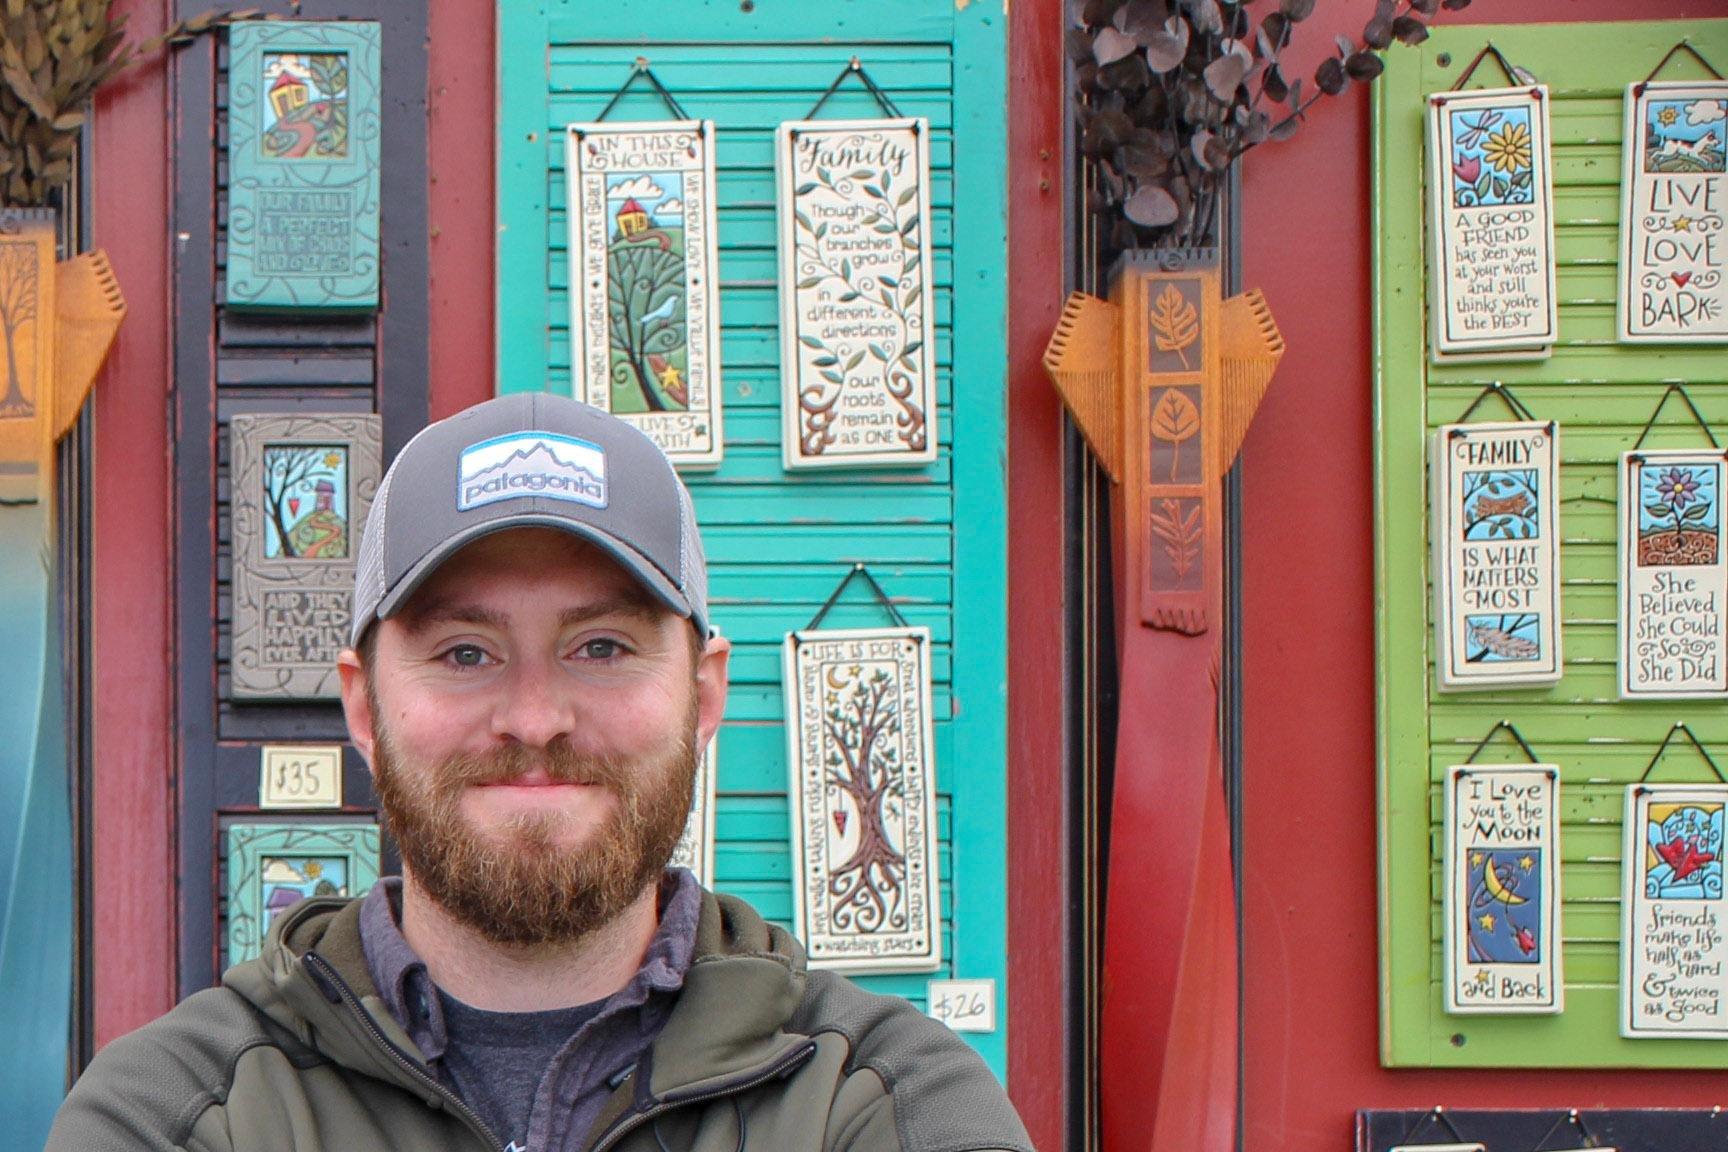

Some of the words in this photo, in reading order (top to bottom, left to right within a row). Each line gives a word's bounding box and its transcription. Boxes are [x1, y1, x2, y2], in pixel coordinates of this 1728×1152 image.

[599, 139, 622, 152] IN
[631, 136, 674, 152] THIS
[612, 153, 682, 168] HOUSE
[799, 137, 909, 174] Family
[1651, 179, 1719, 212] LIVE
[812, 205, 864, 220] Though
[1456, 214, 1471, 227] A
[832, 223, 861, 236] our
[1463, 228, 1529, 246] FRIEND
[827, 238, 892, 252] branches
[1456, 246, 1477, 262] has
[1483, 246, 1511, 261] seen
[1515, 246, 1536, 259] you
[1644, 236, 1721, 266] LOVE
[854, 254, 889, 268] grow
[1456, 265, 1468, 278] at
[1472, 266, 1499, 280] your
[1504, 262, 1538, 275] worst
[1468, 282, 1493, 294] and
[1499, 279, 1526, 294] still
[819, 291, 830, 302] in
[1457, 298, 1497, 313] thinks
[808, 306, 878, 322] different
[1643, 292, 1711, 328] BARK
[823, 322, 897, 338] directions
[1465, 316, 1489, 330] the
[1493, 315, 1531, 329] BEST
[850, 376, 880, 388] our
[843, 392, 885, 408] roots
[841, 412, 894, 426] remain
[842, 433, 861, 444] as
[865, 430, 894, 444] ONE
[1456, 440, 1539, 465] FAMILY
[466, 472, 601, 503] patagonia
[1463, 550, 1478, 566] IS
[1486, 547, 1539, 565] WHAT
[1463, 567, 1538, 587] MATTERS
[1653, 573, 1696, 593] She
[265, 592, 300, 609] AND
[307, 592, 349, 611] THEY
[1464, 589, 1538, 608] MOST
[1640, 592, 1714, 613] Believed
[264, 608, 349, 627] LIVED
[1637, 616, 1665, 639] She
[1670, 614, 1718, 637] Could
[265, 627, 350, 648] HAPPILY
[810, 643, 841, 659] LIFE
[851, 642, 863, 657] IS
[873, 641, 904, 659] FOR
[1639, 658, 1672, 681] She
[1681, 660, 1716, 681] Did
[276, 762, 320, 795] $35
[1470, 781, 1483, 798] I
[1491, 780, 1541, 800] Love
[1464, 806, 1494, 828] you
[1500, 804, 1514, 825] to
[1519, 804, 1543, 822] the
[1646, 932, 1688, 946] make
[1696, 927, 1721, 951] life
[1647, 948, 1678, 964] half
[1684, 950, 1701, 960] as
[1678, 962, 1720, 978] hard
[1464, 980, 1494, 998] and
[1502, 978, 1544, 998] Back
[1644, 974, 1666, 996] &
[1669, 987, 1719, 998] twice
[934, 990, 985, 1019] $26
[1644, 1003, 1663, 1015] as
[1666, 1000, 1717, 1021] good
